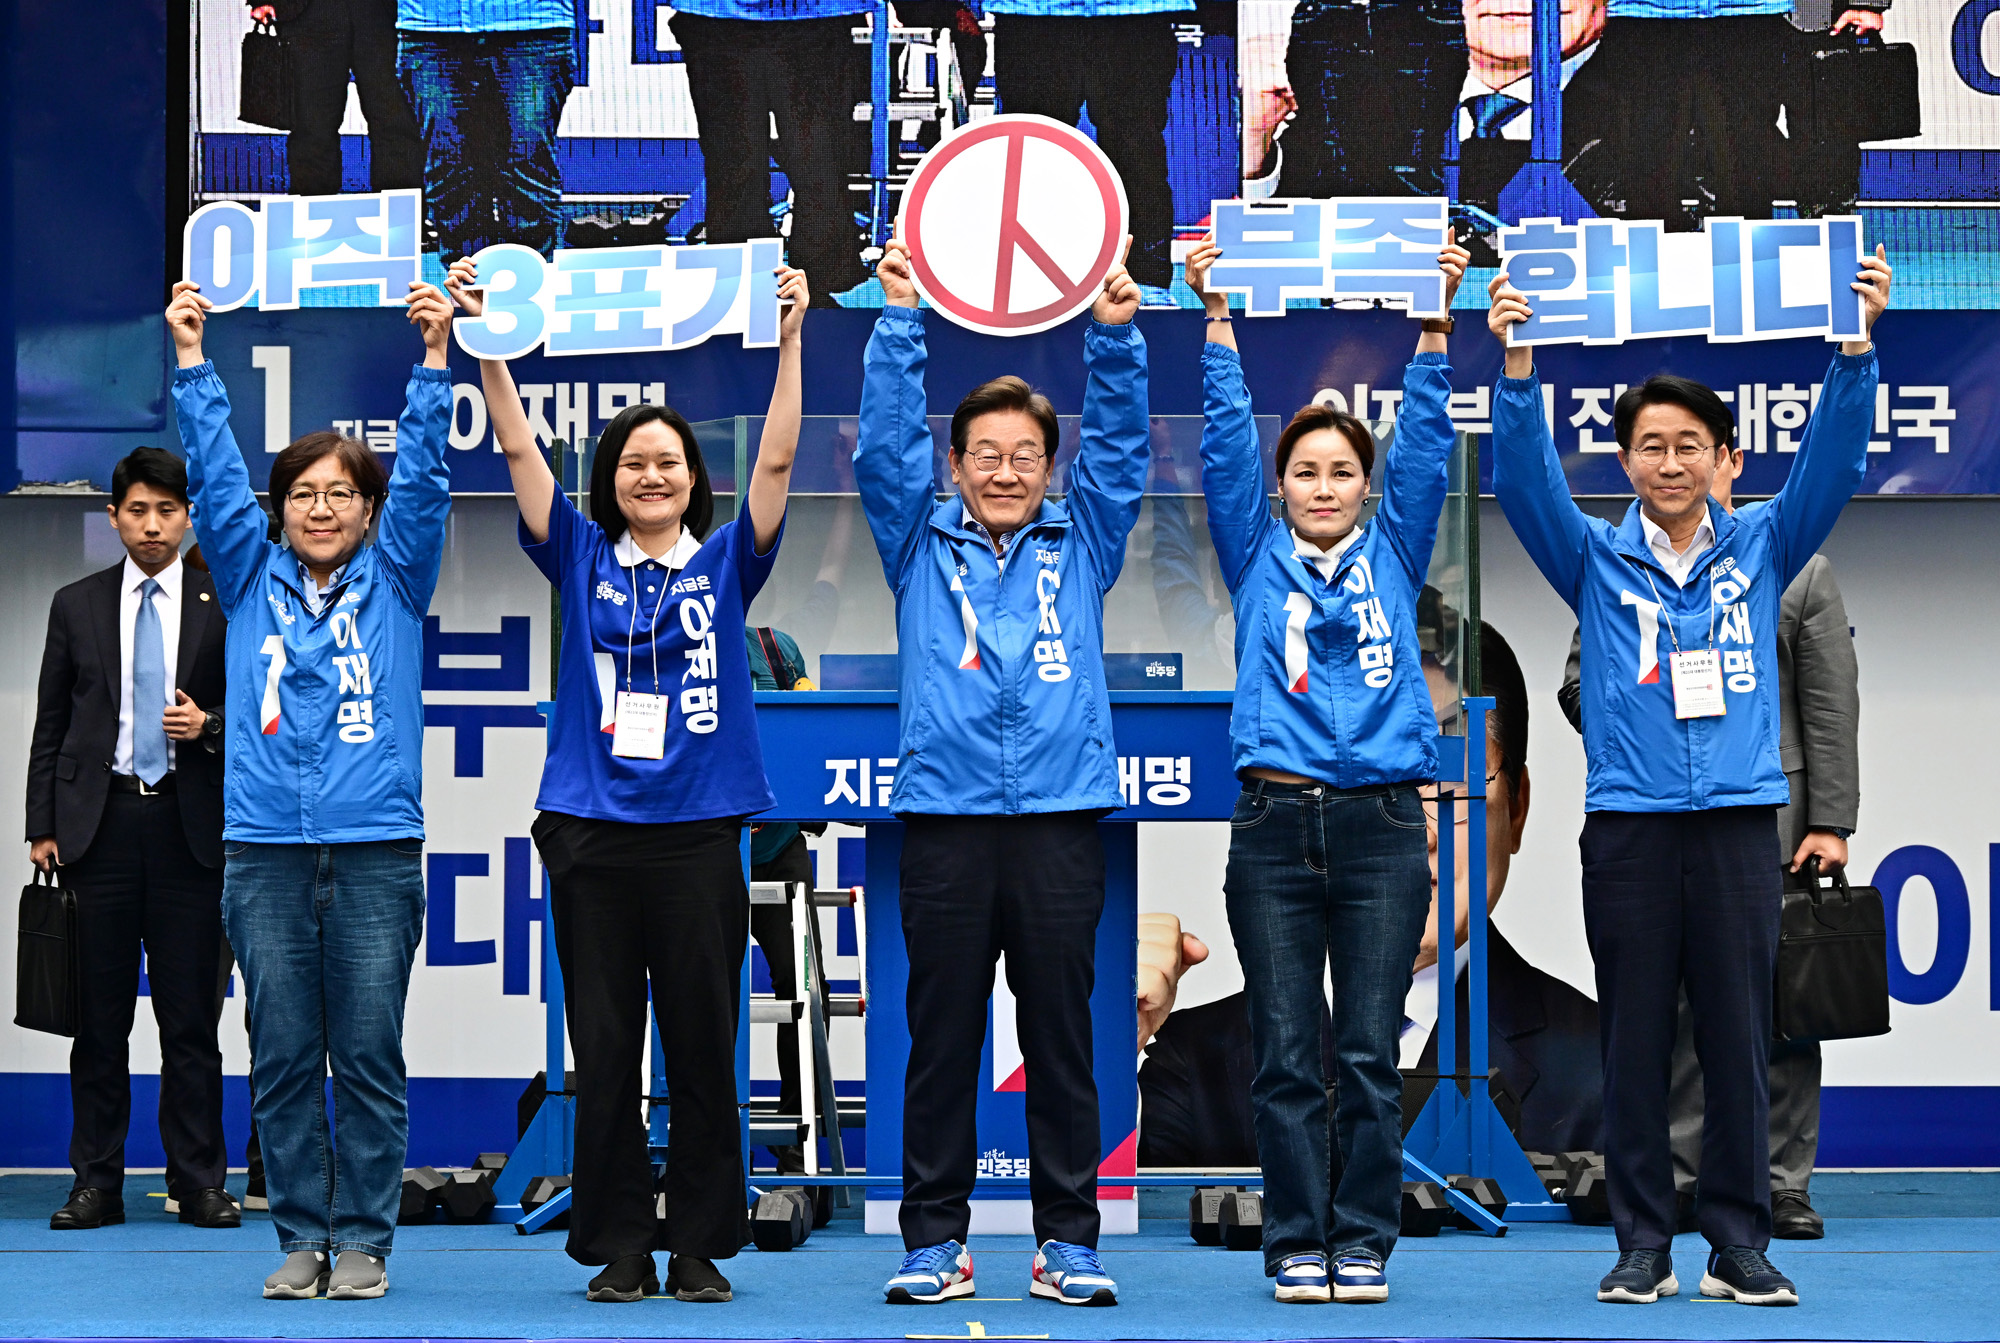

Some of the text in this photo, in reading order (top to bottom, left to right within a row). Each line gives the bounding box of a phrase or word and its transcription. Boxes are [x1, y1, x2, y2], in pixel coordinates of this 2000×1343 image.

[189, 195, 416, 308] 아직
[1209, 202, 1443, 313] 부족
[1503, 219, 1860, 342] 합니다
[252, 346, 290, 453] 1
[332, 420, 397, 452] 지금
[670, 575, 711, 596] 지금은
[1342, 554, 1393, 688] 이재명
[1620, 589, 1661, 684] 1
[1713, 567, 1756, 693] 이재명
[260, 635, 287, 735] 1
[330, 609, 375, 743] 이재명
[679, 594, 718, 734] 이재명
[1145, 665, 1177, 677] 민주당
[1282, 592, 1312, 693] 1
